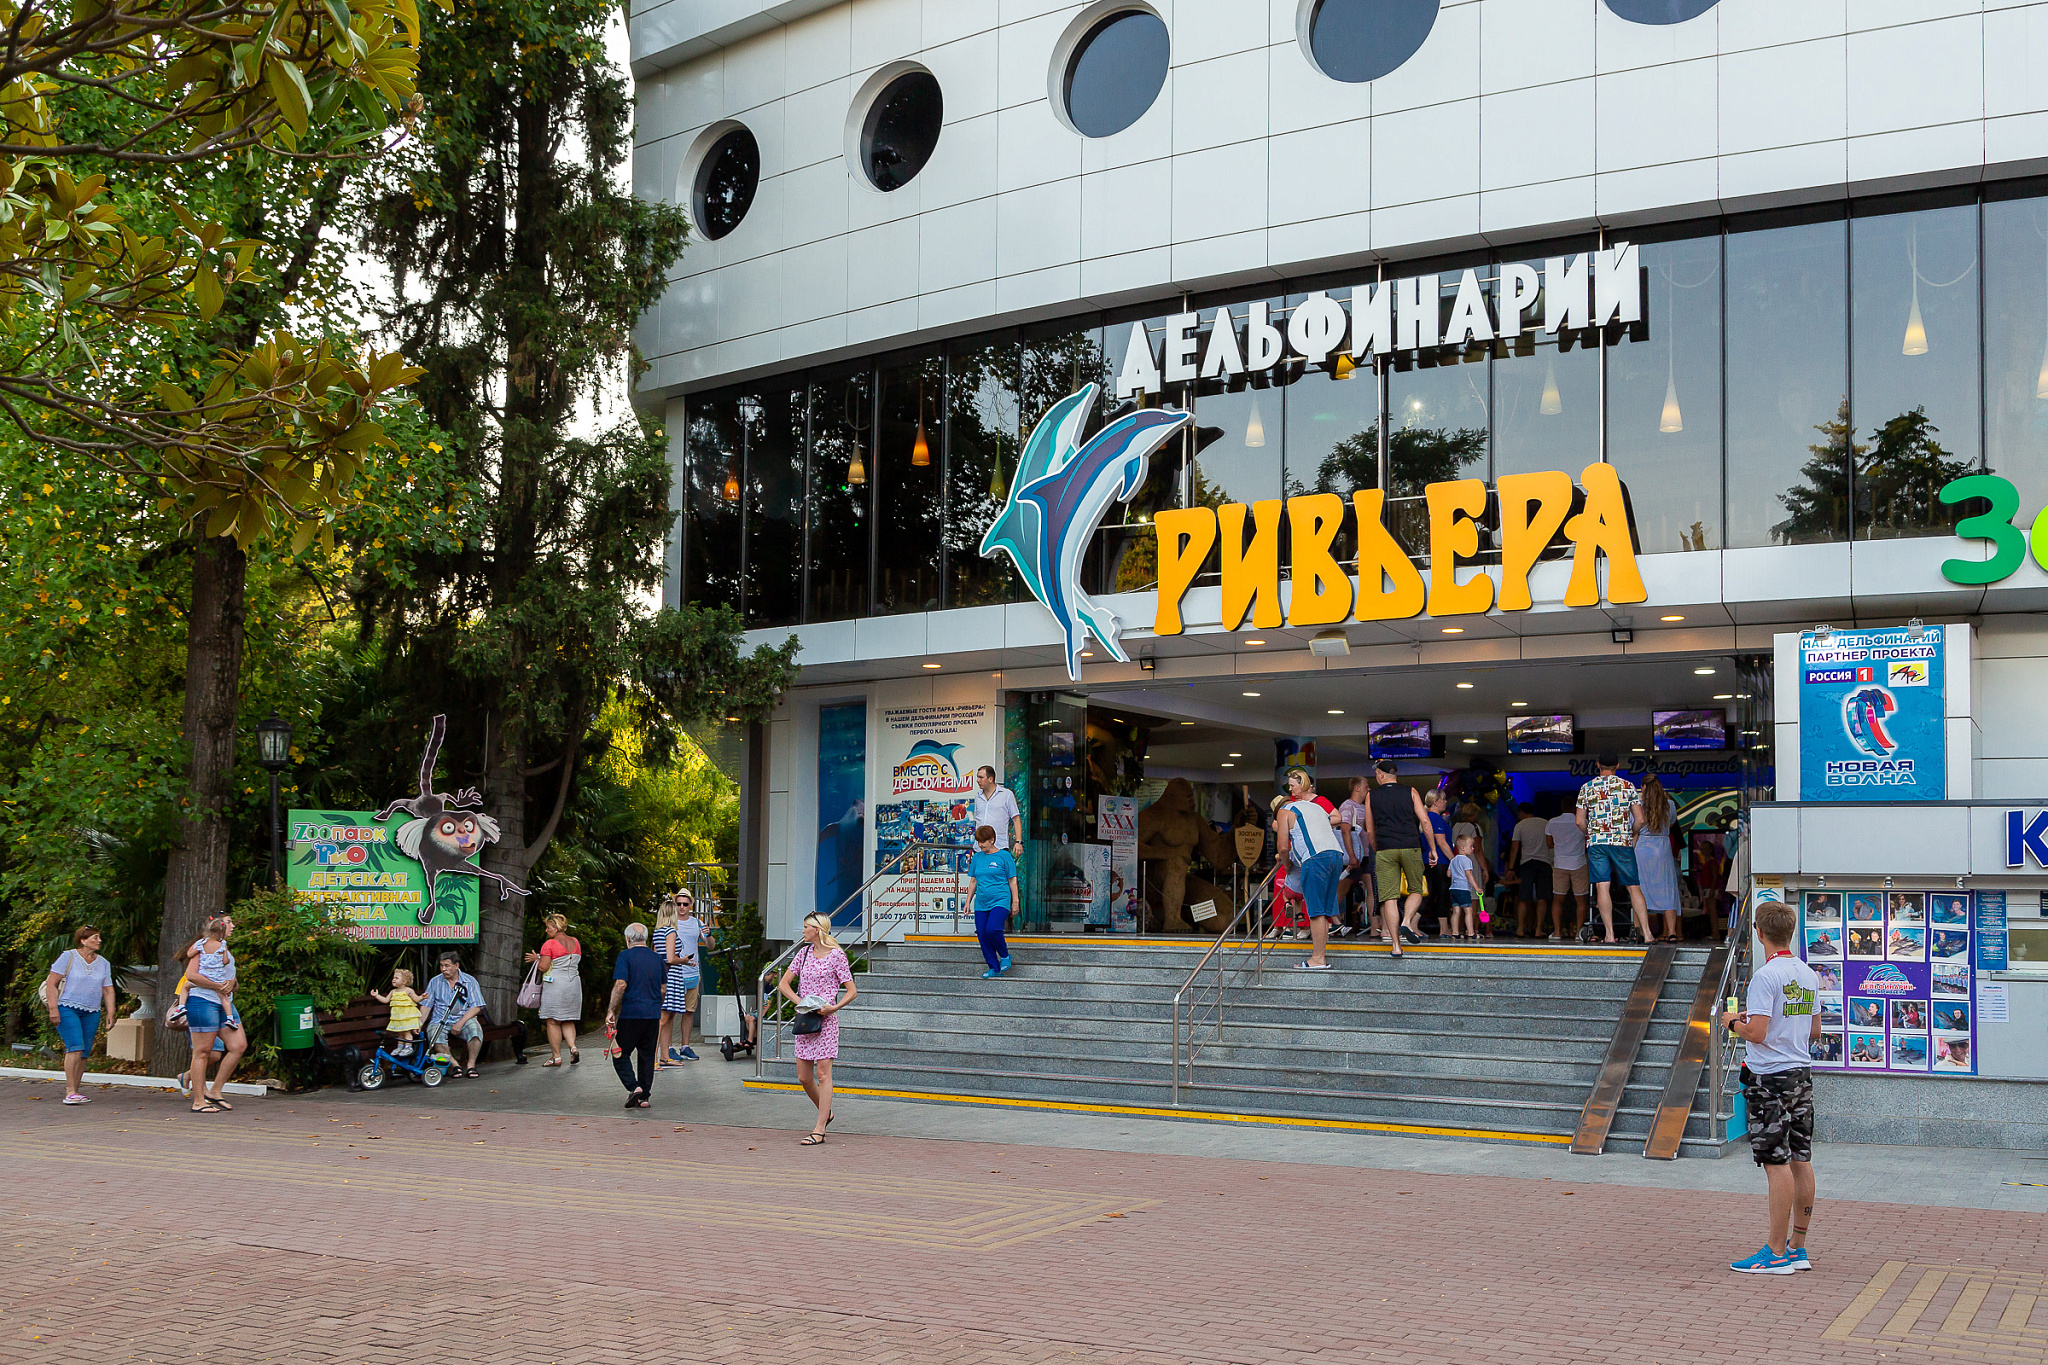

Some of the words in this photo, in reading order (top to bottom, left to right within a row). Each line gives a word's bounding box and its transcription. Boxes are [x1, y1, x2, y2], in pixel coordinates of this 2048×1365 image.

[1116, 241, 1641, 399] ДЕЛЬФИНАРИЙ
[1939, 474, 2048, 585] З
[1153, 462, 1649, 636] РИВЬЕРА
[1802, 639, 1833, 649] НА
[1807, 651, 1868, 662] ПАРТНЕР
[1872, 647, 1935, 659] ПРОЕКТА
[1809, 670, 1852, 682] РОССИЯ
[1860, 668, 1868, 681] 1
[884, 708, 918, 716] УВАЖАЕМЫЕ
[951, 711, 984, 719] ПРОХОДИЛИ
[914, 720, 952, 728] ПОПУЛЯРНОГО
[1827, 760, 1914, 773] НОВАЯ
[1827, 772, 1916, 785] ВОЛНА
[308, 872, 408, 887] ДЕТСКАЯ
[1756, 877, 1764, 886] 44
